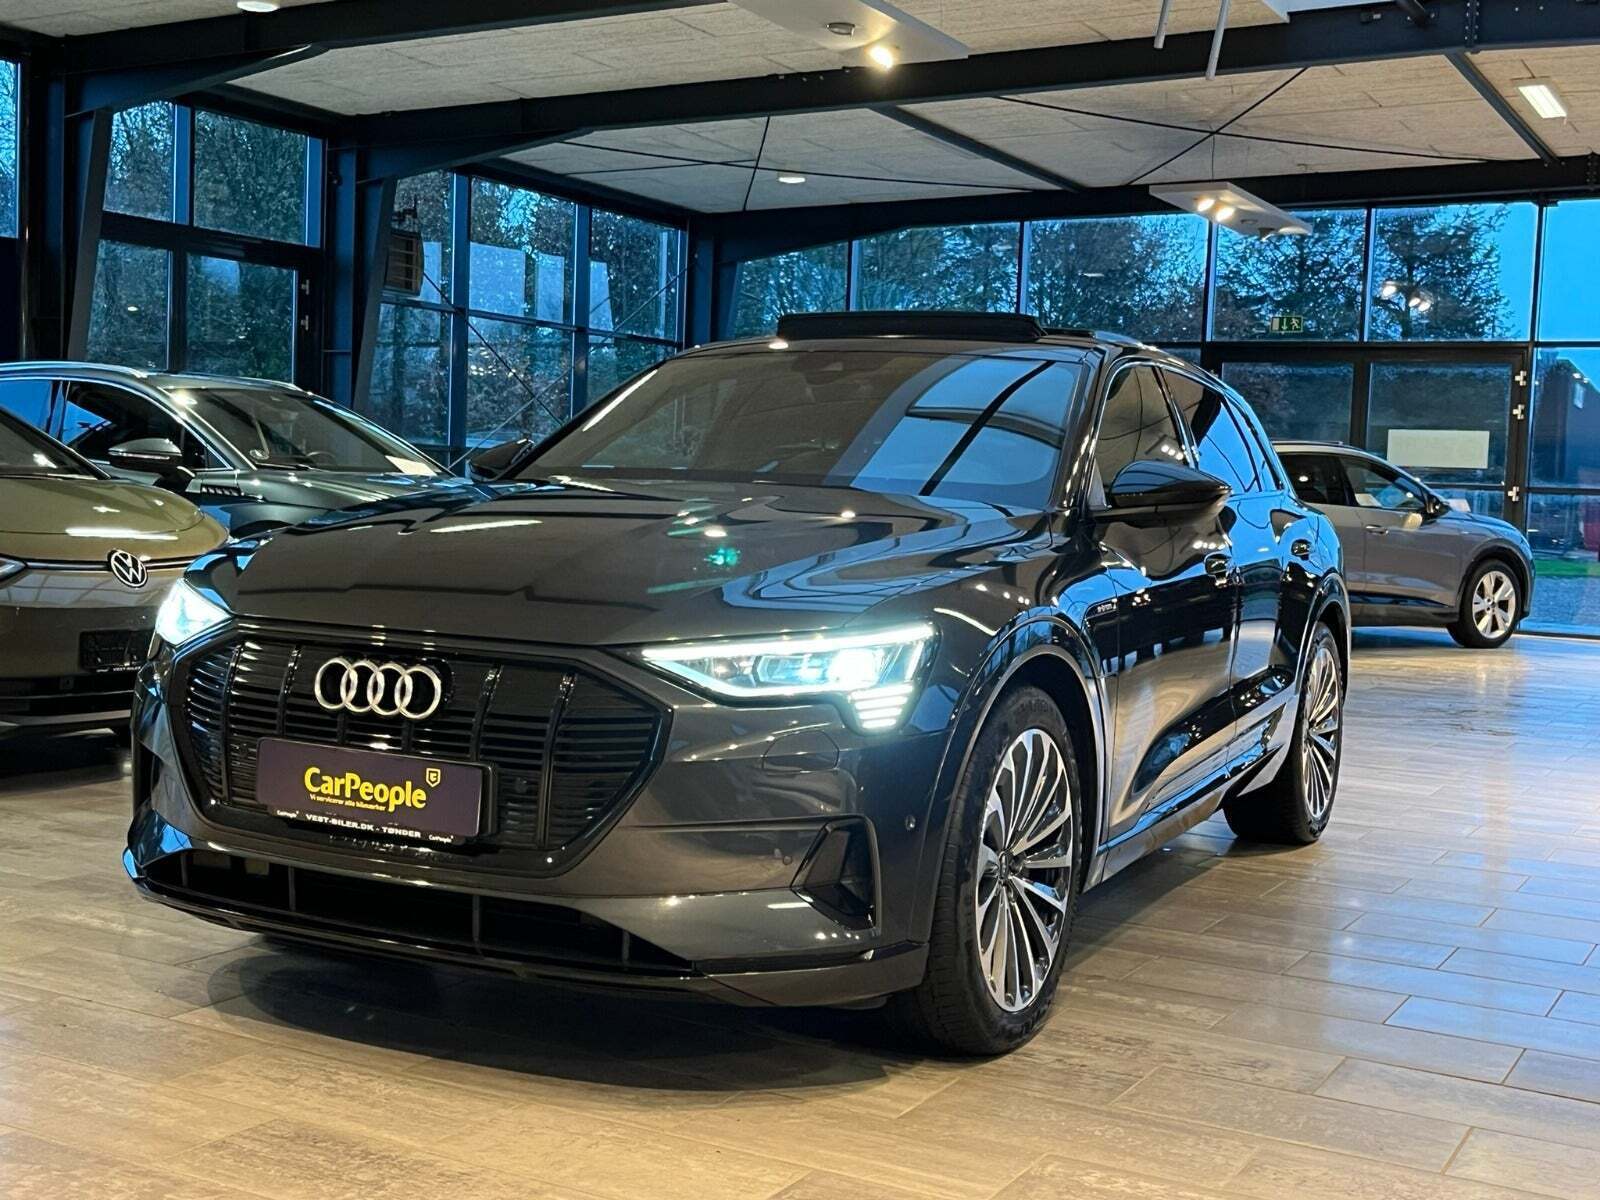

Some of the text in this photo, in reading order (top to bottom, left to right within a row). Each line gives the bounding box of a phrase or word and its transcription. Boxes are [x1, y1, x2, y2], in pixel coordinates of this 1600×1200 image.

[304, 766, 427, 812] CarPeople
[305, 813, 374, 831] VEST-BILER.DK
[381, 826, 421, 838] TØNDER
